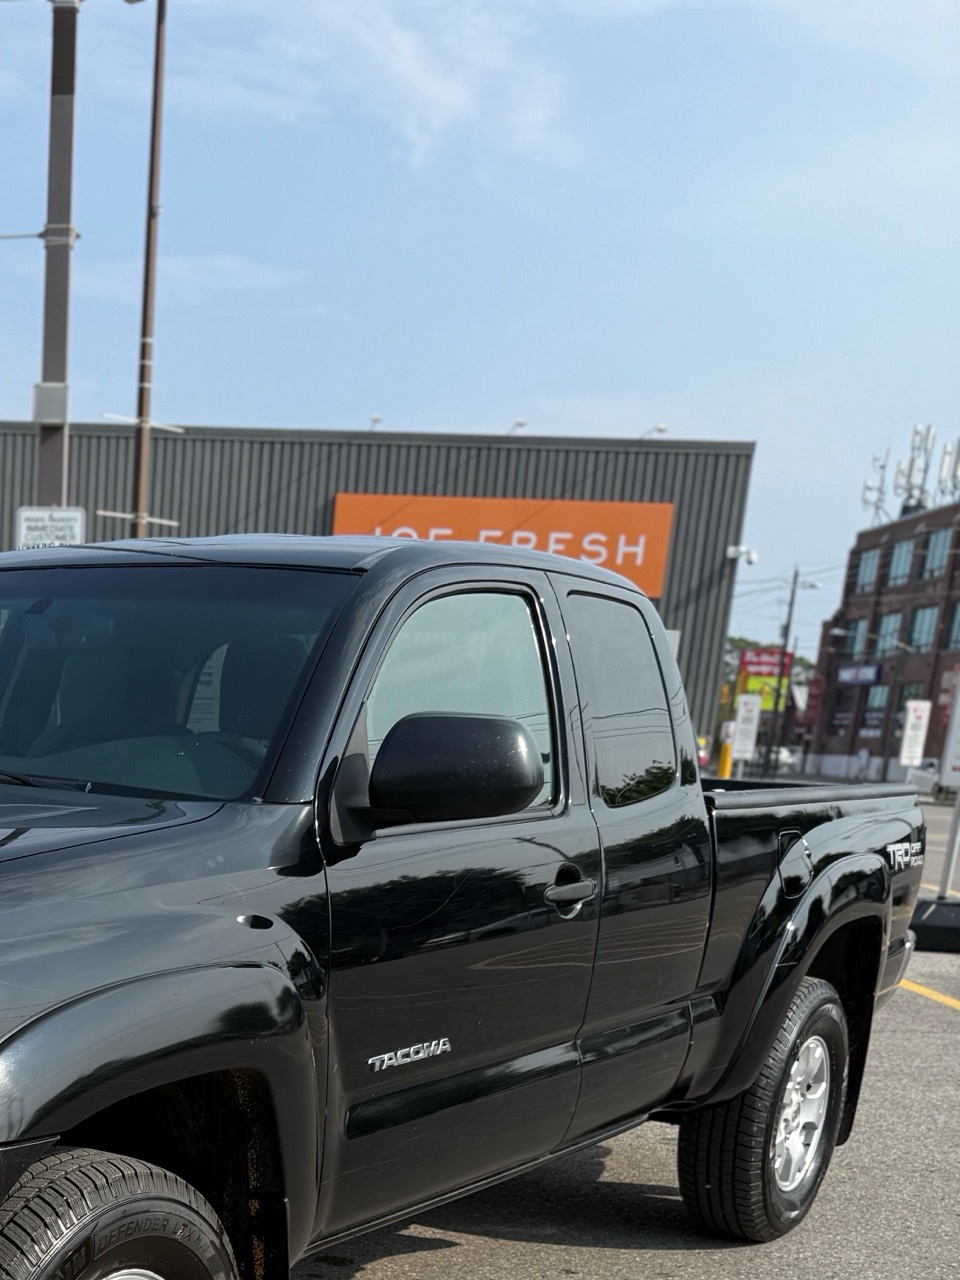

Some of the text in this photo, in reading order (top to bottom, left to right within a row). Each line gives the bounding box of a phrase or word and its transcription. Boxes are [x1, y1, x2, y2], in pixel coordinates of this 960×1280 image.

[886, 842, 911, 871] TRD
[910, 842, 922, 853] OFF
[910, 854, 924, 867] ROAD
[367, 1037, 452, 1073] TACOMA
[98, 1216, 170, 1253] DEFENDER
[172, 1220, 197, 1243] LTX
